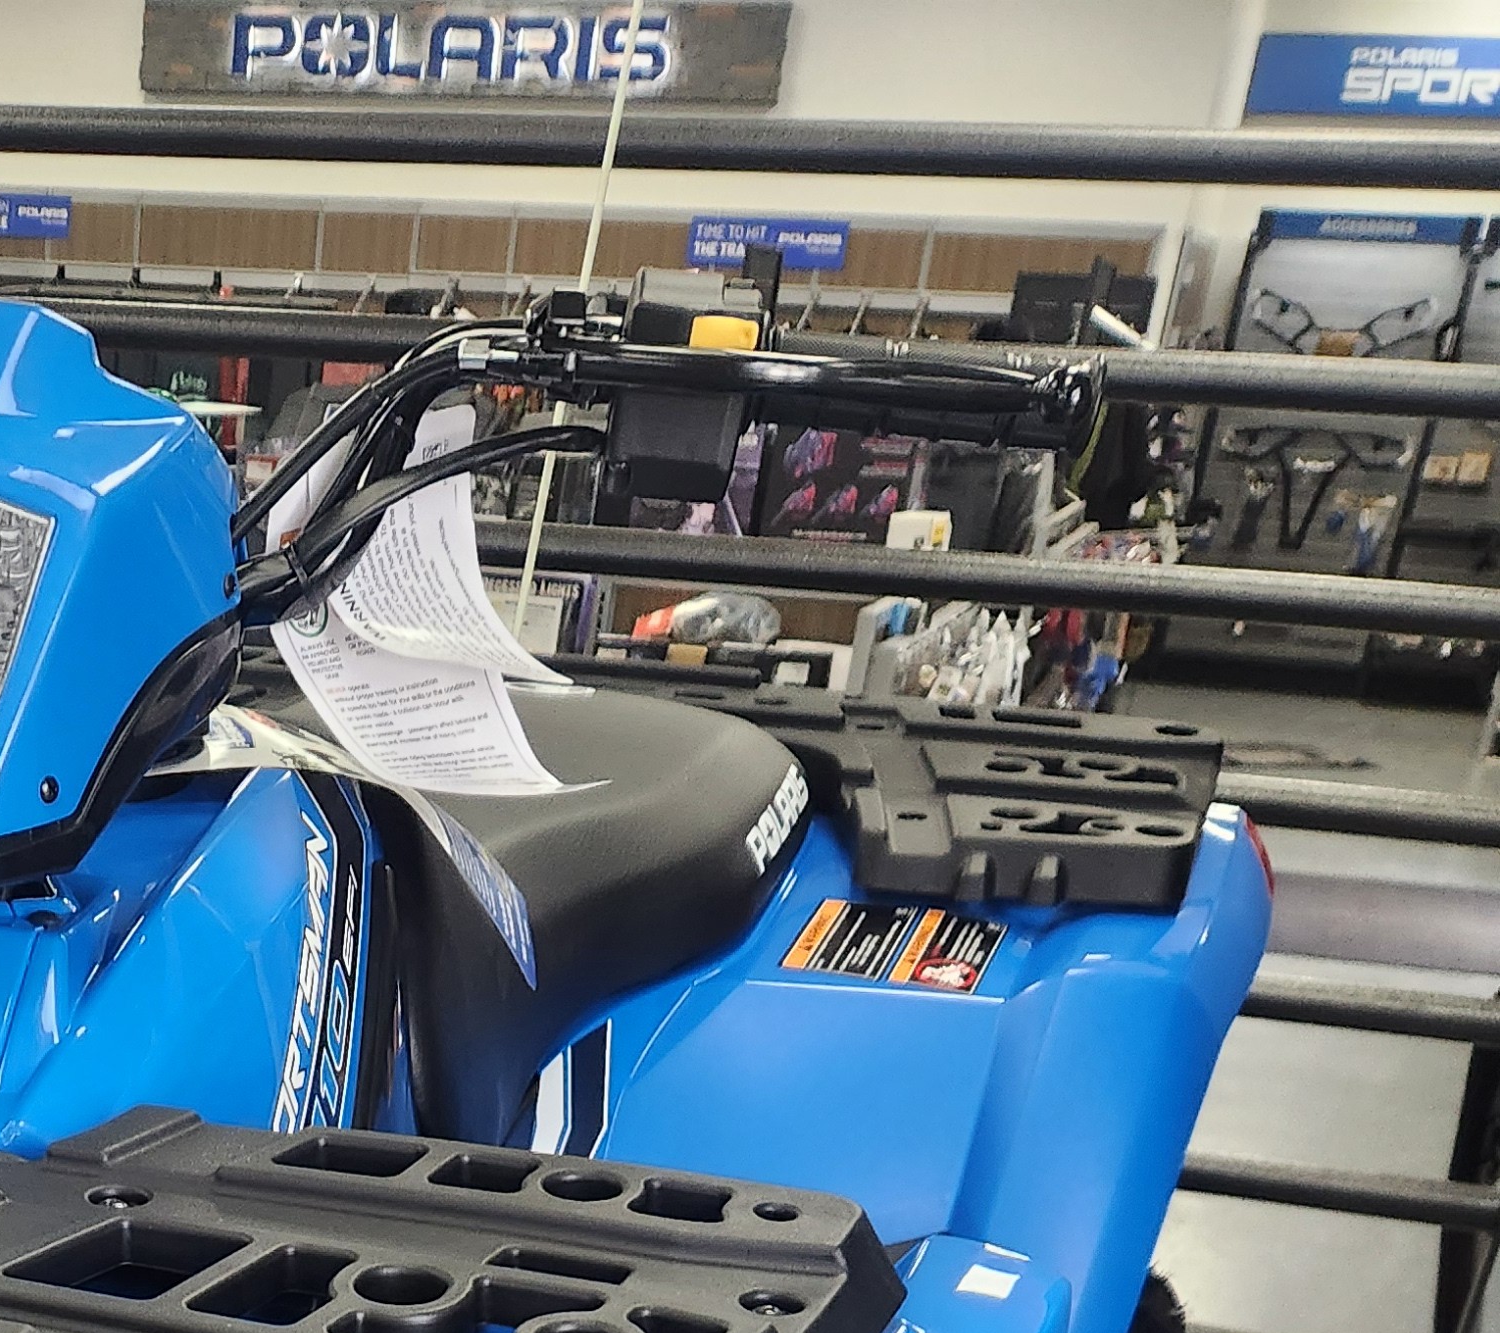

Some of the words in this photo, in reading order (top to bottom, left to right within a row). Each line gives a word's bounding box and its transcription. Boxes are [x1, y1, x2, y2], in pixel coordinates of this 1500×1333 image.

[231, 13, 671, 82] POLARIS
[1350, 47, 1459, 66] POLARIS
[18, 205, 68, 218] POLARIS
[697, 223, 724, 239] TIME
[729, 224, 744, 239] TO
[745, 224, 767, 240] HIT
[778, 232, 842, 245] POLARIS
[694, 240, 718, 257] THE
[720, 241, 747, 258] TRA
[745, 763, 809, 878] POLARIS
[343, 864, 358, 976] EFI
[273, 811, 329, 1134] ORTSMAN
